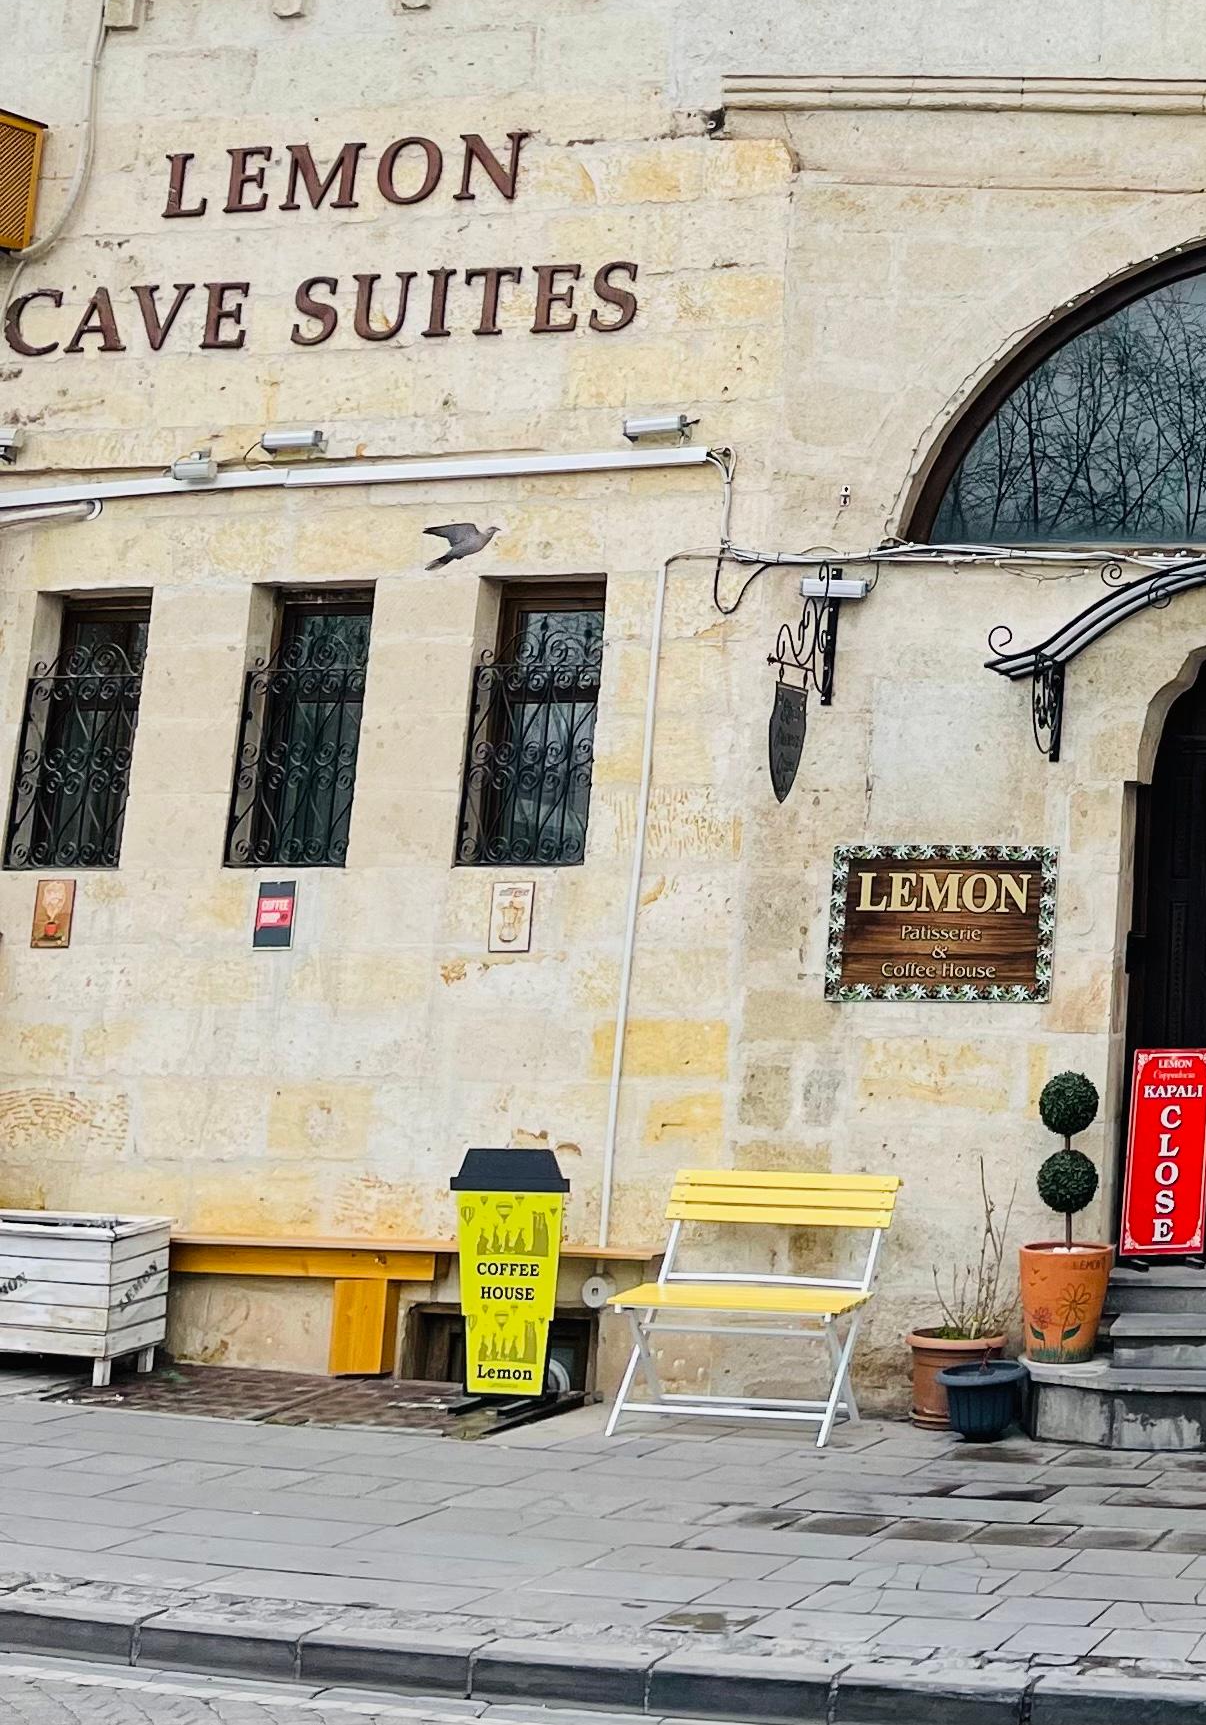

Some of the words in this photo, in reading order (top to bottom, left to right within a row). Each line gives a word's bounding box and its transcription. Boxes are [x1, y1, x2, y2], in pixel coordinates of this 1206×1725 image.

[161, 131, 531, 219] LEMON
[4, 281, 251, 357] CAVE
[289, 261, 640, 347] SUITES
[855, 872, 1033, 914] LEMON
[900, 925, 983, 941] Patisserie
[931, 945, 948, 959] &
[881, 962, 936, 978] Coffee
[942, 962, 997, 979] House
[1158, 1059, 1193, 1069] LEMON
[1144, 1084, 1204, 1098] KAPALI
[1152, 1105, 1182, 1243] CLOSE
[476, 1262, 540, 1277] COFFEE
[480, 1286, 535, 1301] HOUSE
[477, 1364, 533, 1381] Lemon
